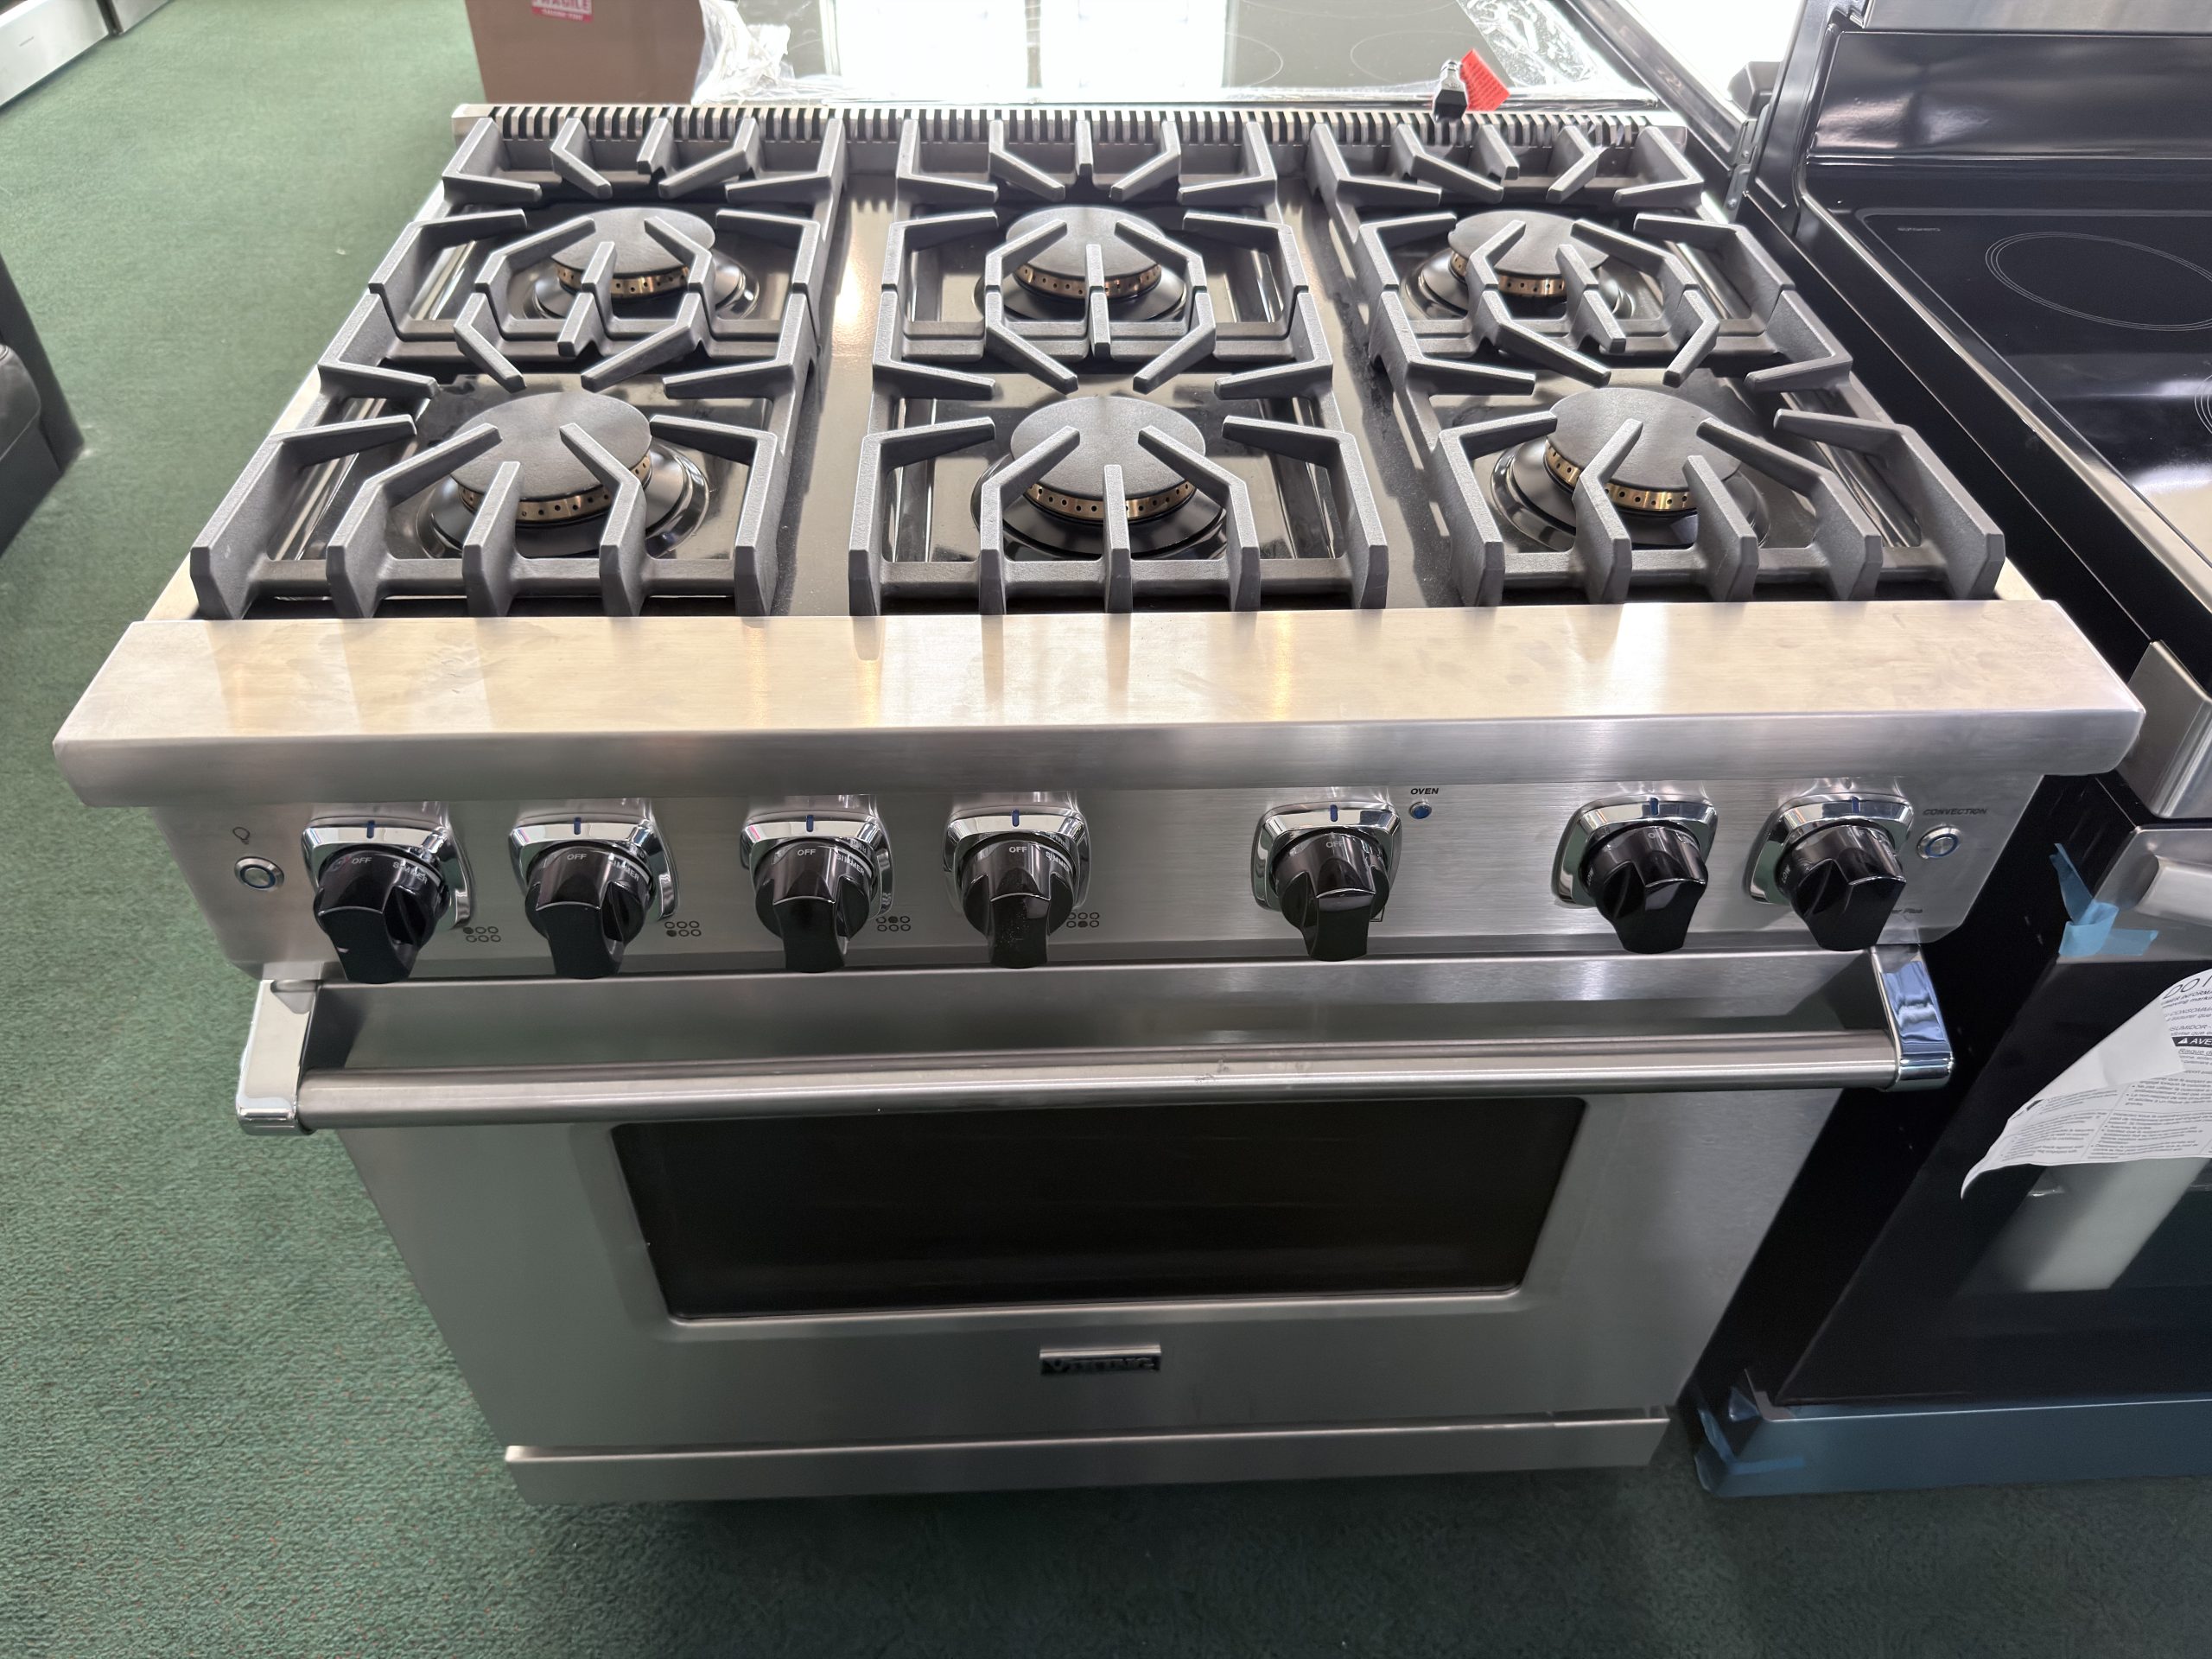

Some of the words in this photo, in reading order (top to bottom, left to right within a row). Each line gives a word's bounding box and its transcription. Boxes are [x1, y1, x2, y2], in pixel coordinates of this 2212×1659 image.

[836, 852, 865, 876] SIMMER
[1045, 850, 1070, 873] SIMMER
[2163, 977, 2201, 1000] DO
